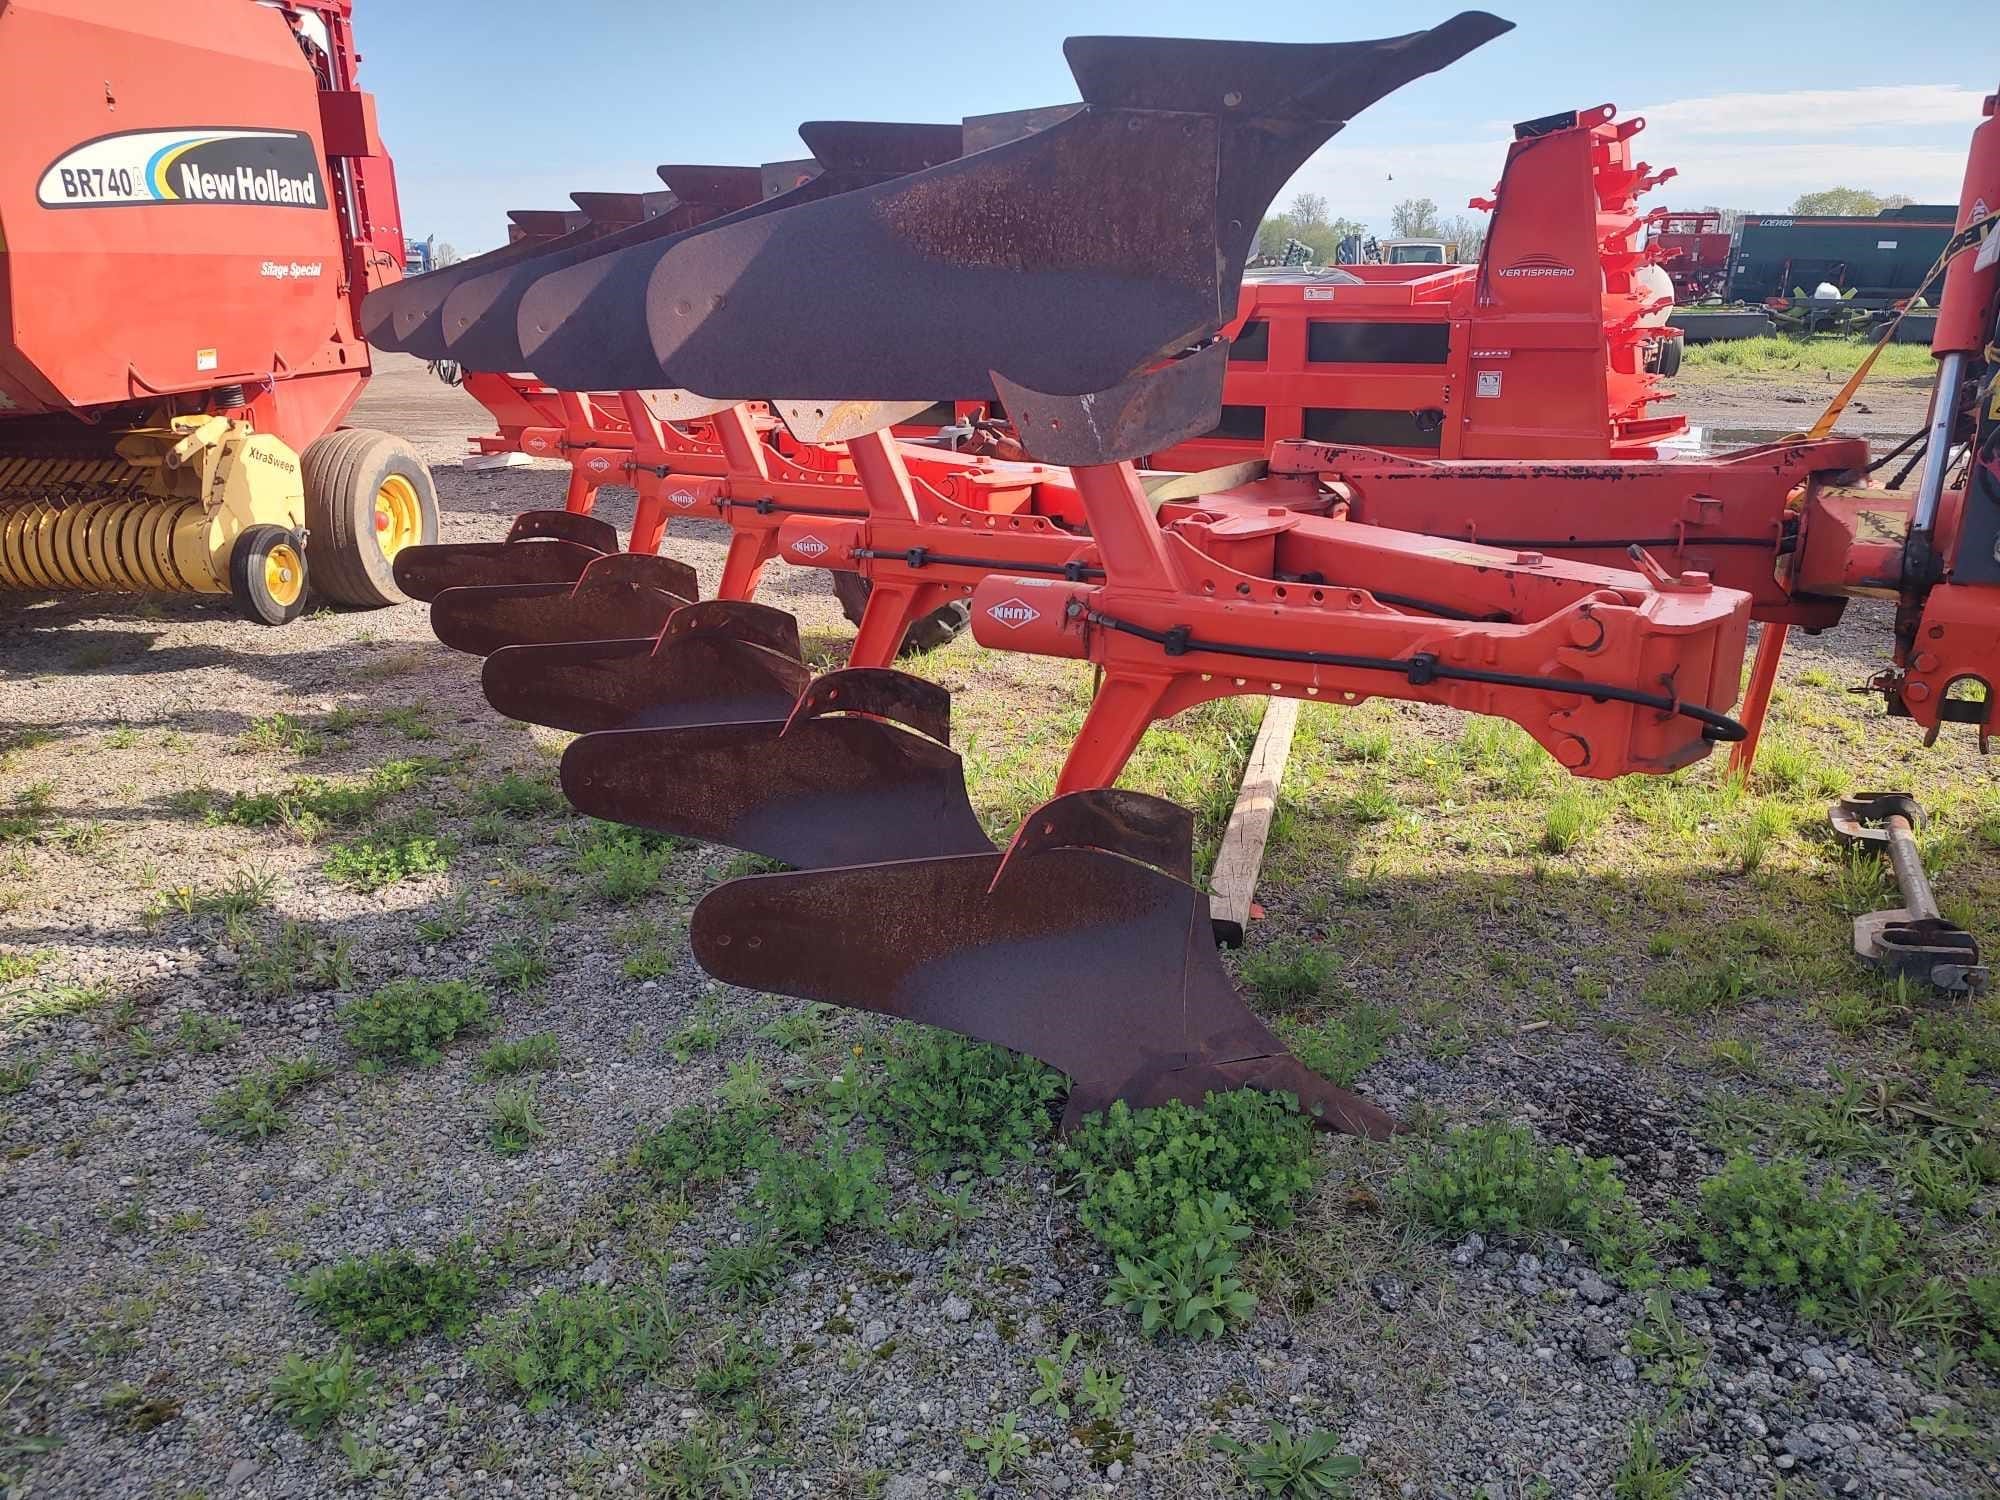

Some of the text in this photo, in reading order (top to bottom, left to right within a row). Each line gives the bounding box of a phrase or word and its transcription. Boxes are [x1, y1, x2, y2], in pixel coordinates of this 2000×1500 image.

[180, 163, 316, 204] New Holland
[290, 261, 322, 279] Special
[1498, 268, 1575, 277] VERTISPREAD
[249, 446, 295, 474] XtraSweep
[795, 542, 824, 552] KUHN
[994, 606, 1033, 620] KUHN
